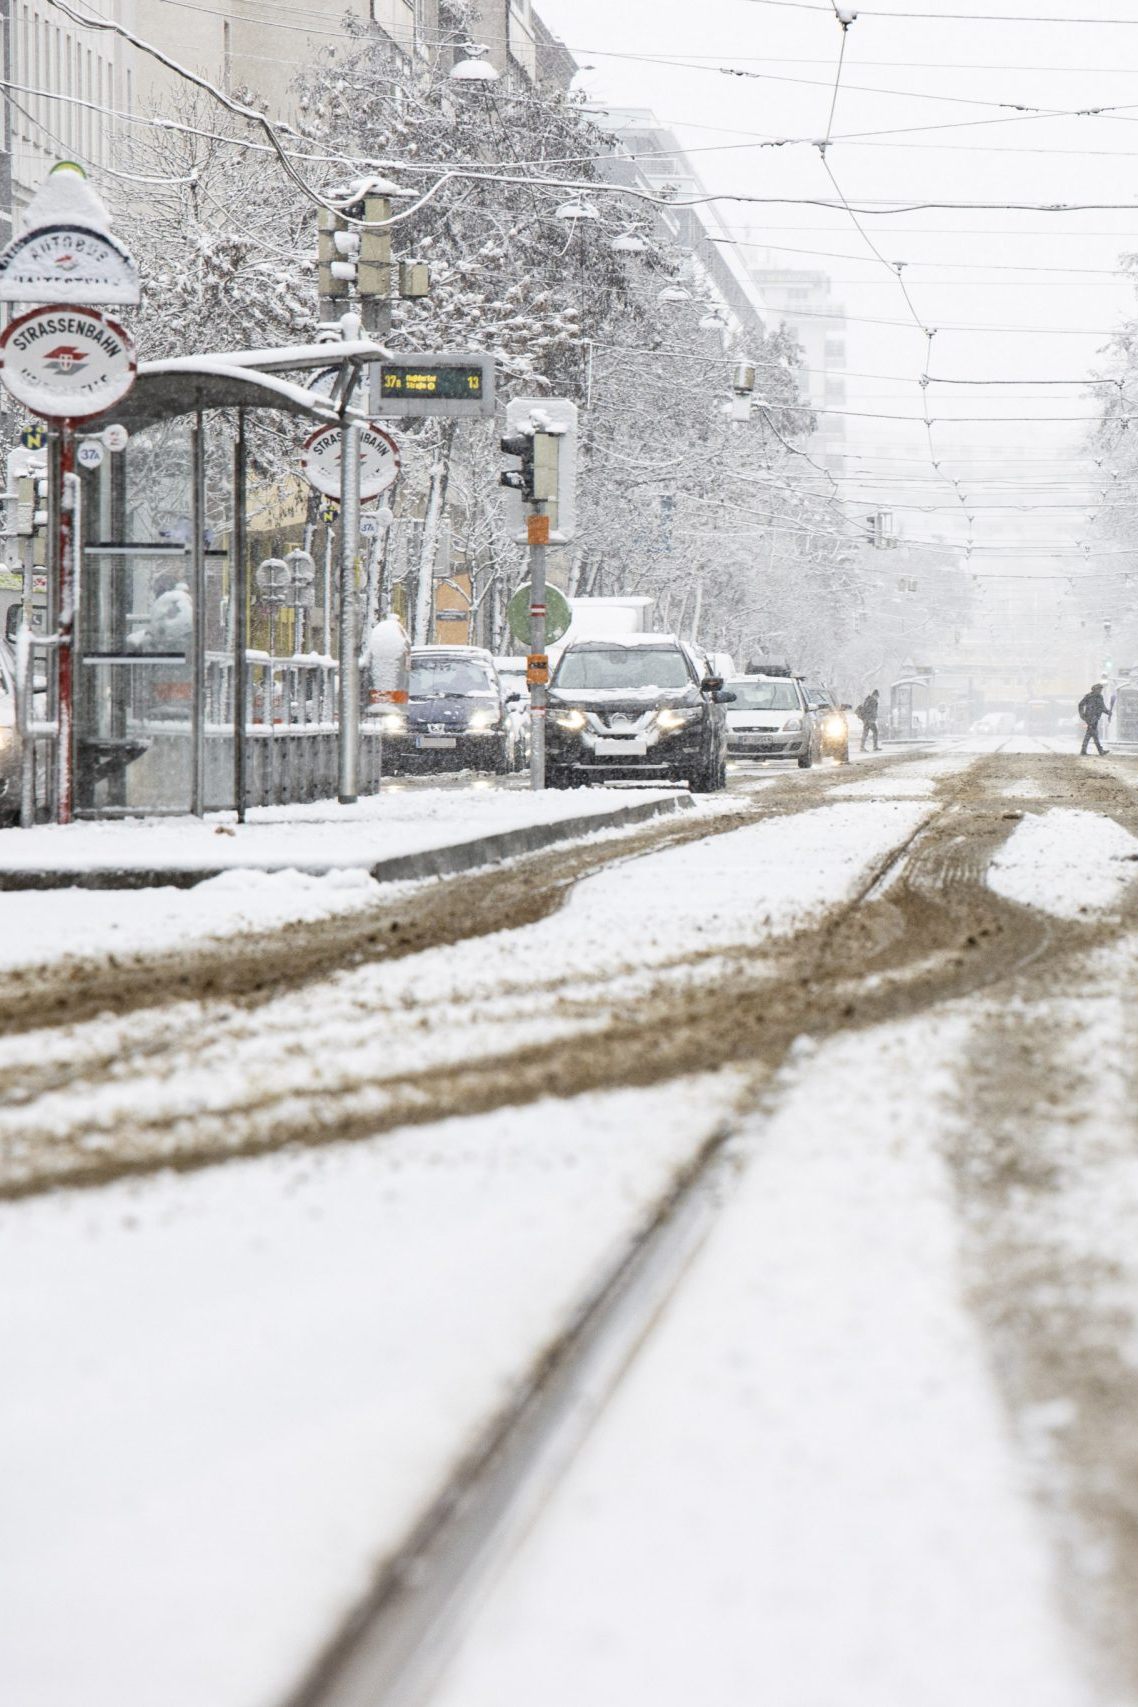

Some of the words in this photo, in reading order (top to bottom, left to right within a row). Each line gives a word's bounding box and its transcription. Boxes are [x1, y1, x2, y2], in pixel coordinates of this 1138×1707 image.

[13, 318, 121, 358] STRASSENBAHN
[467, 375, 480, 389] 13
[80, 449, 100, 460] 37A
